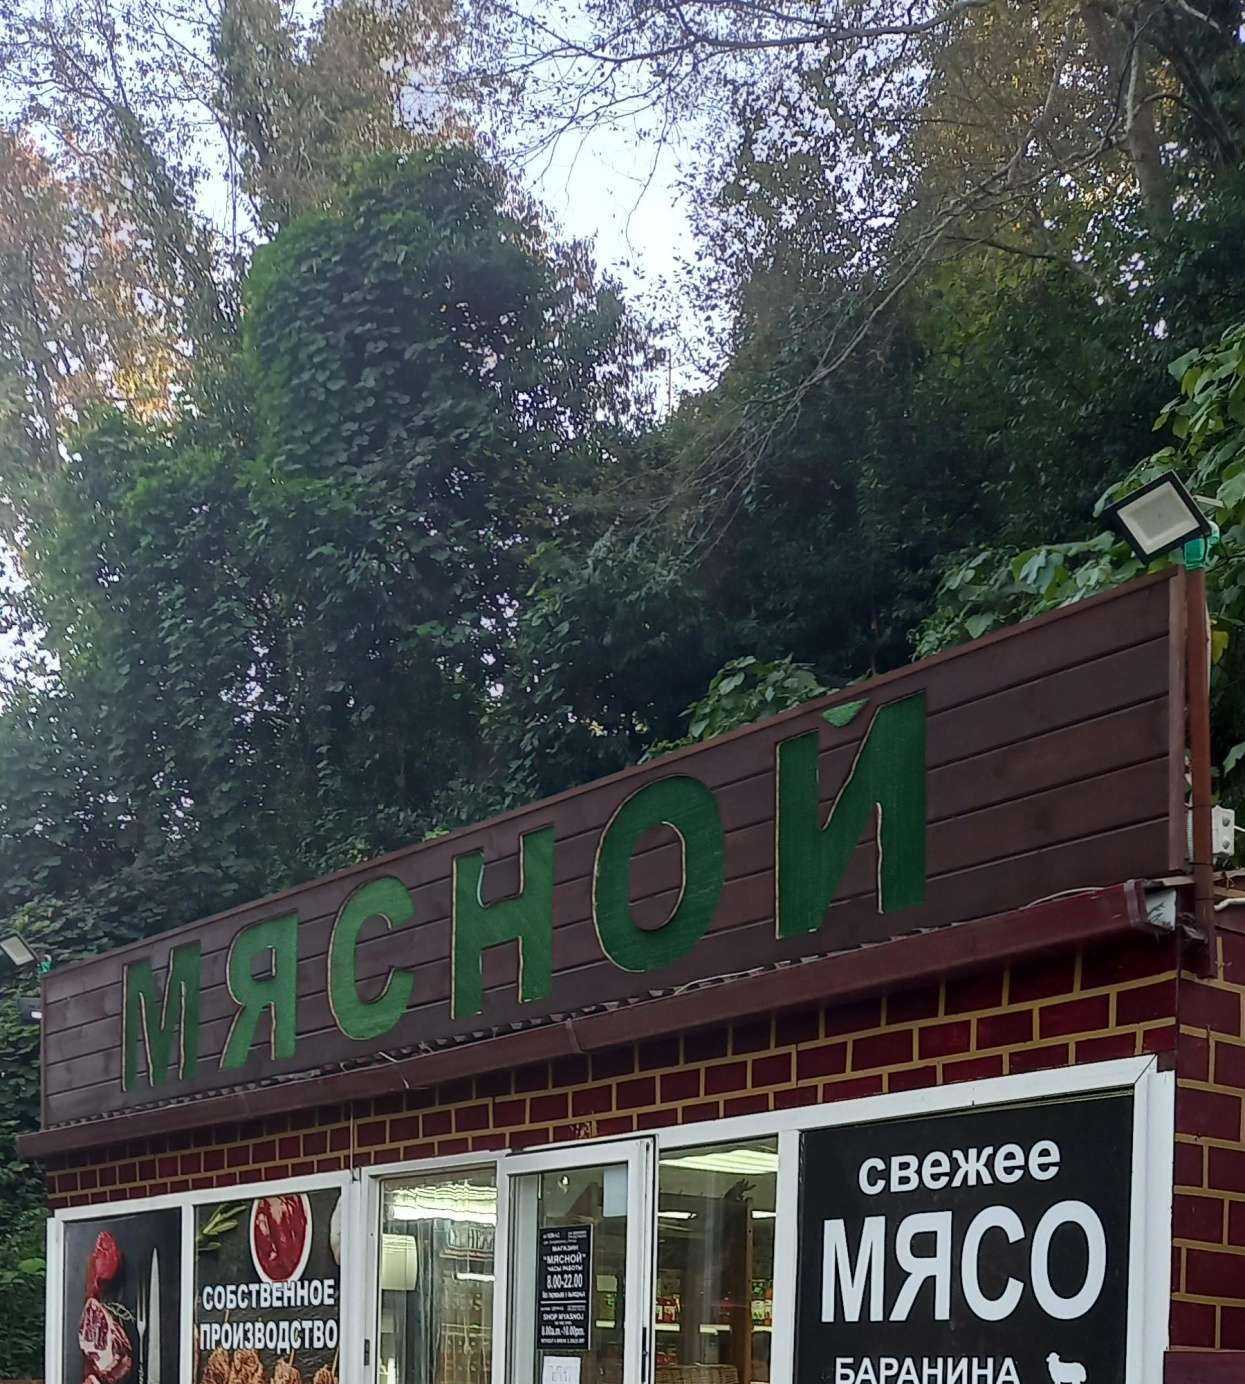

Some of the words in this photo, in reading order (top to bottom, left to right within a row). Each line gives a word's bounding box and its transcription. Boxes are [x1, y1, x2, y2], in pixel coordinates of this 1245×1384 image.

[122, 688, 928, 1093] МЯСНОЙ
[858, 1139, 1060, 1195] свежее
[821, 1200, 1107, 1323] МЯСО
[202, 1278, 336, 1312] СОБСТВЕННОЕ
[200, 1319, 338, 1354] ПРОИЗВОДСТВО
